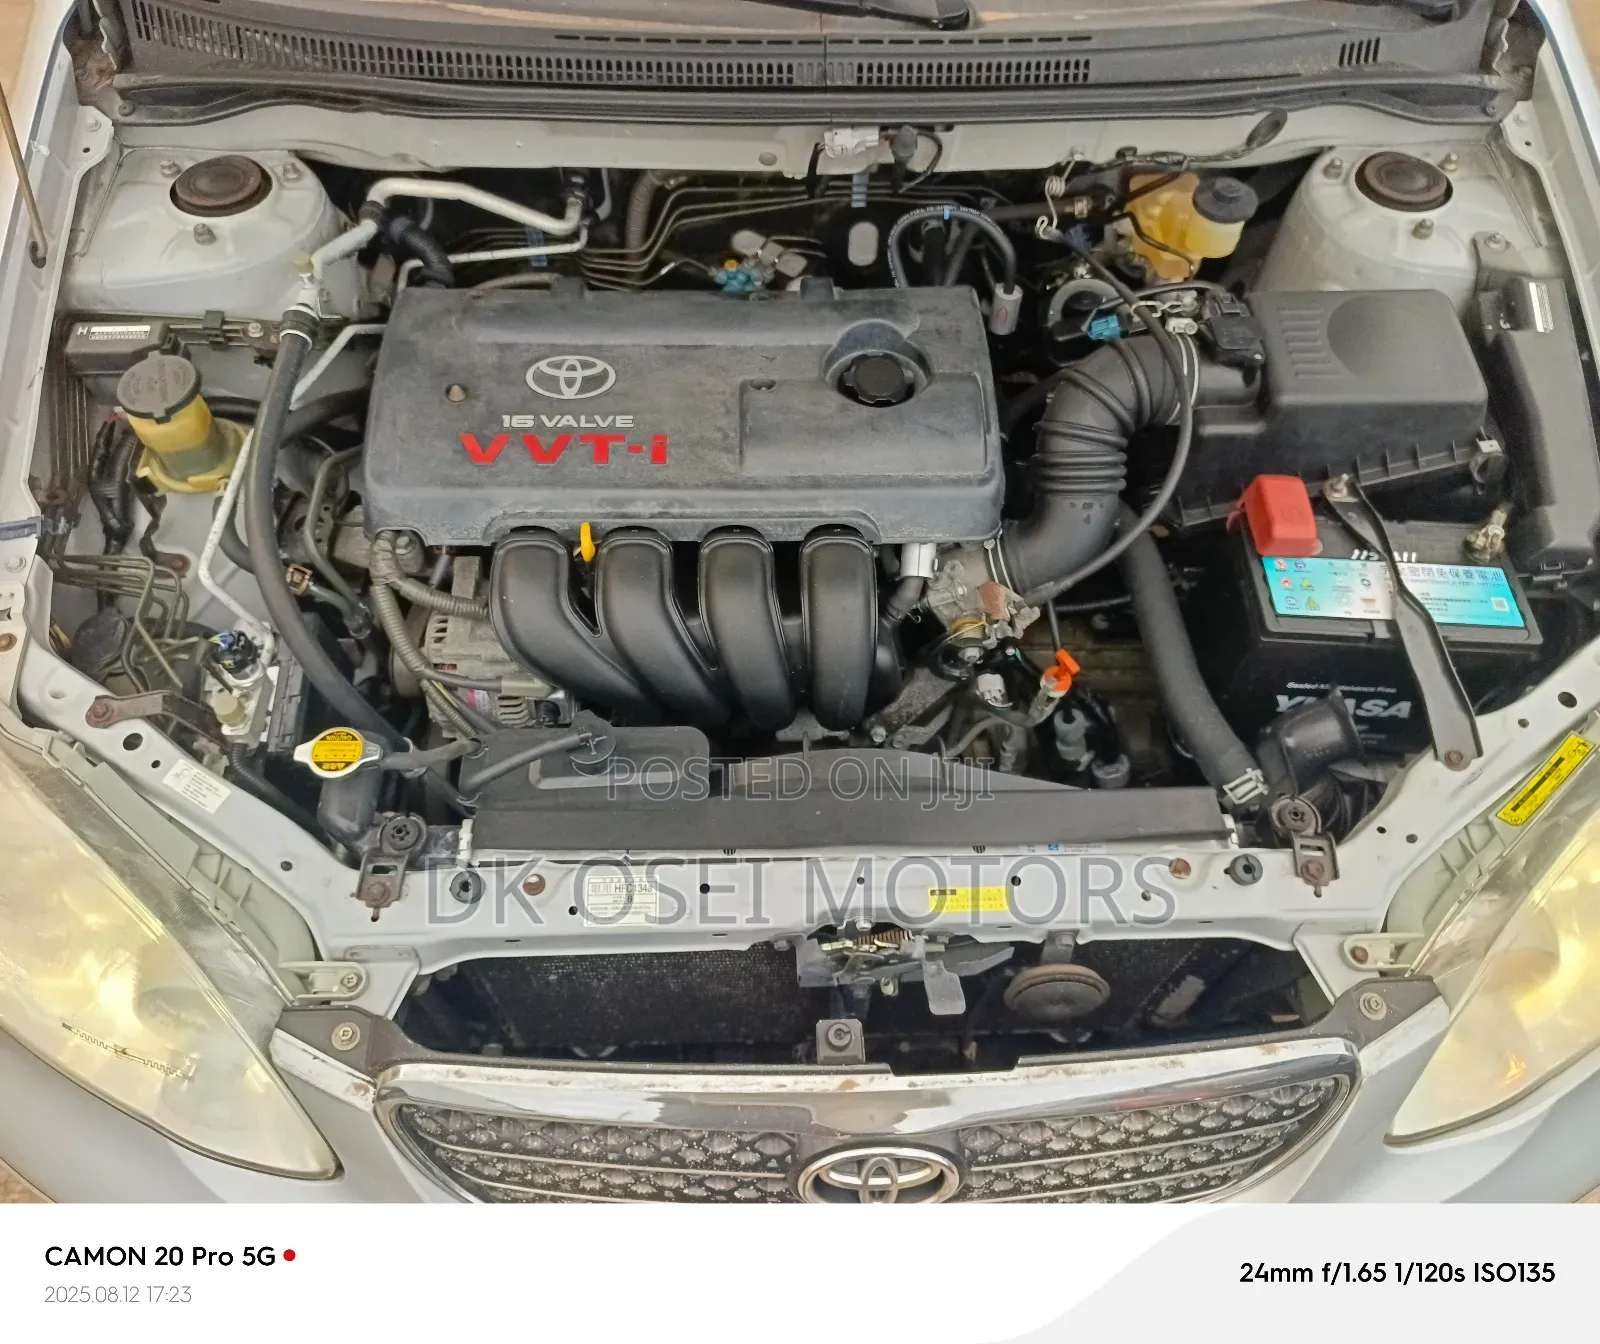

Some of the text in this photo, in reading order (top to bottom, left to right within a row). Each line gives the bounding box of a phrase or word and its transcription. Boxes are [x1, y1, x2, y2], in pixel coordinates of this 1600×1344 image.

[77, 326, 88, 336] H
[502, 414, 634, 428] 16 VALVE
[460, 433, 668, 464] VVT-i
[1276, 694, 1412, 719] YSA
